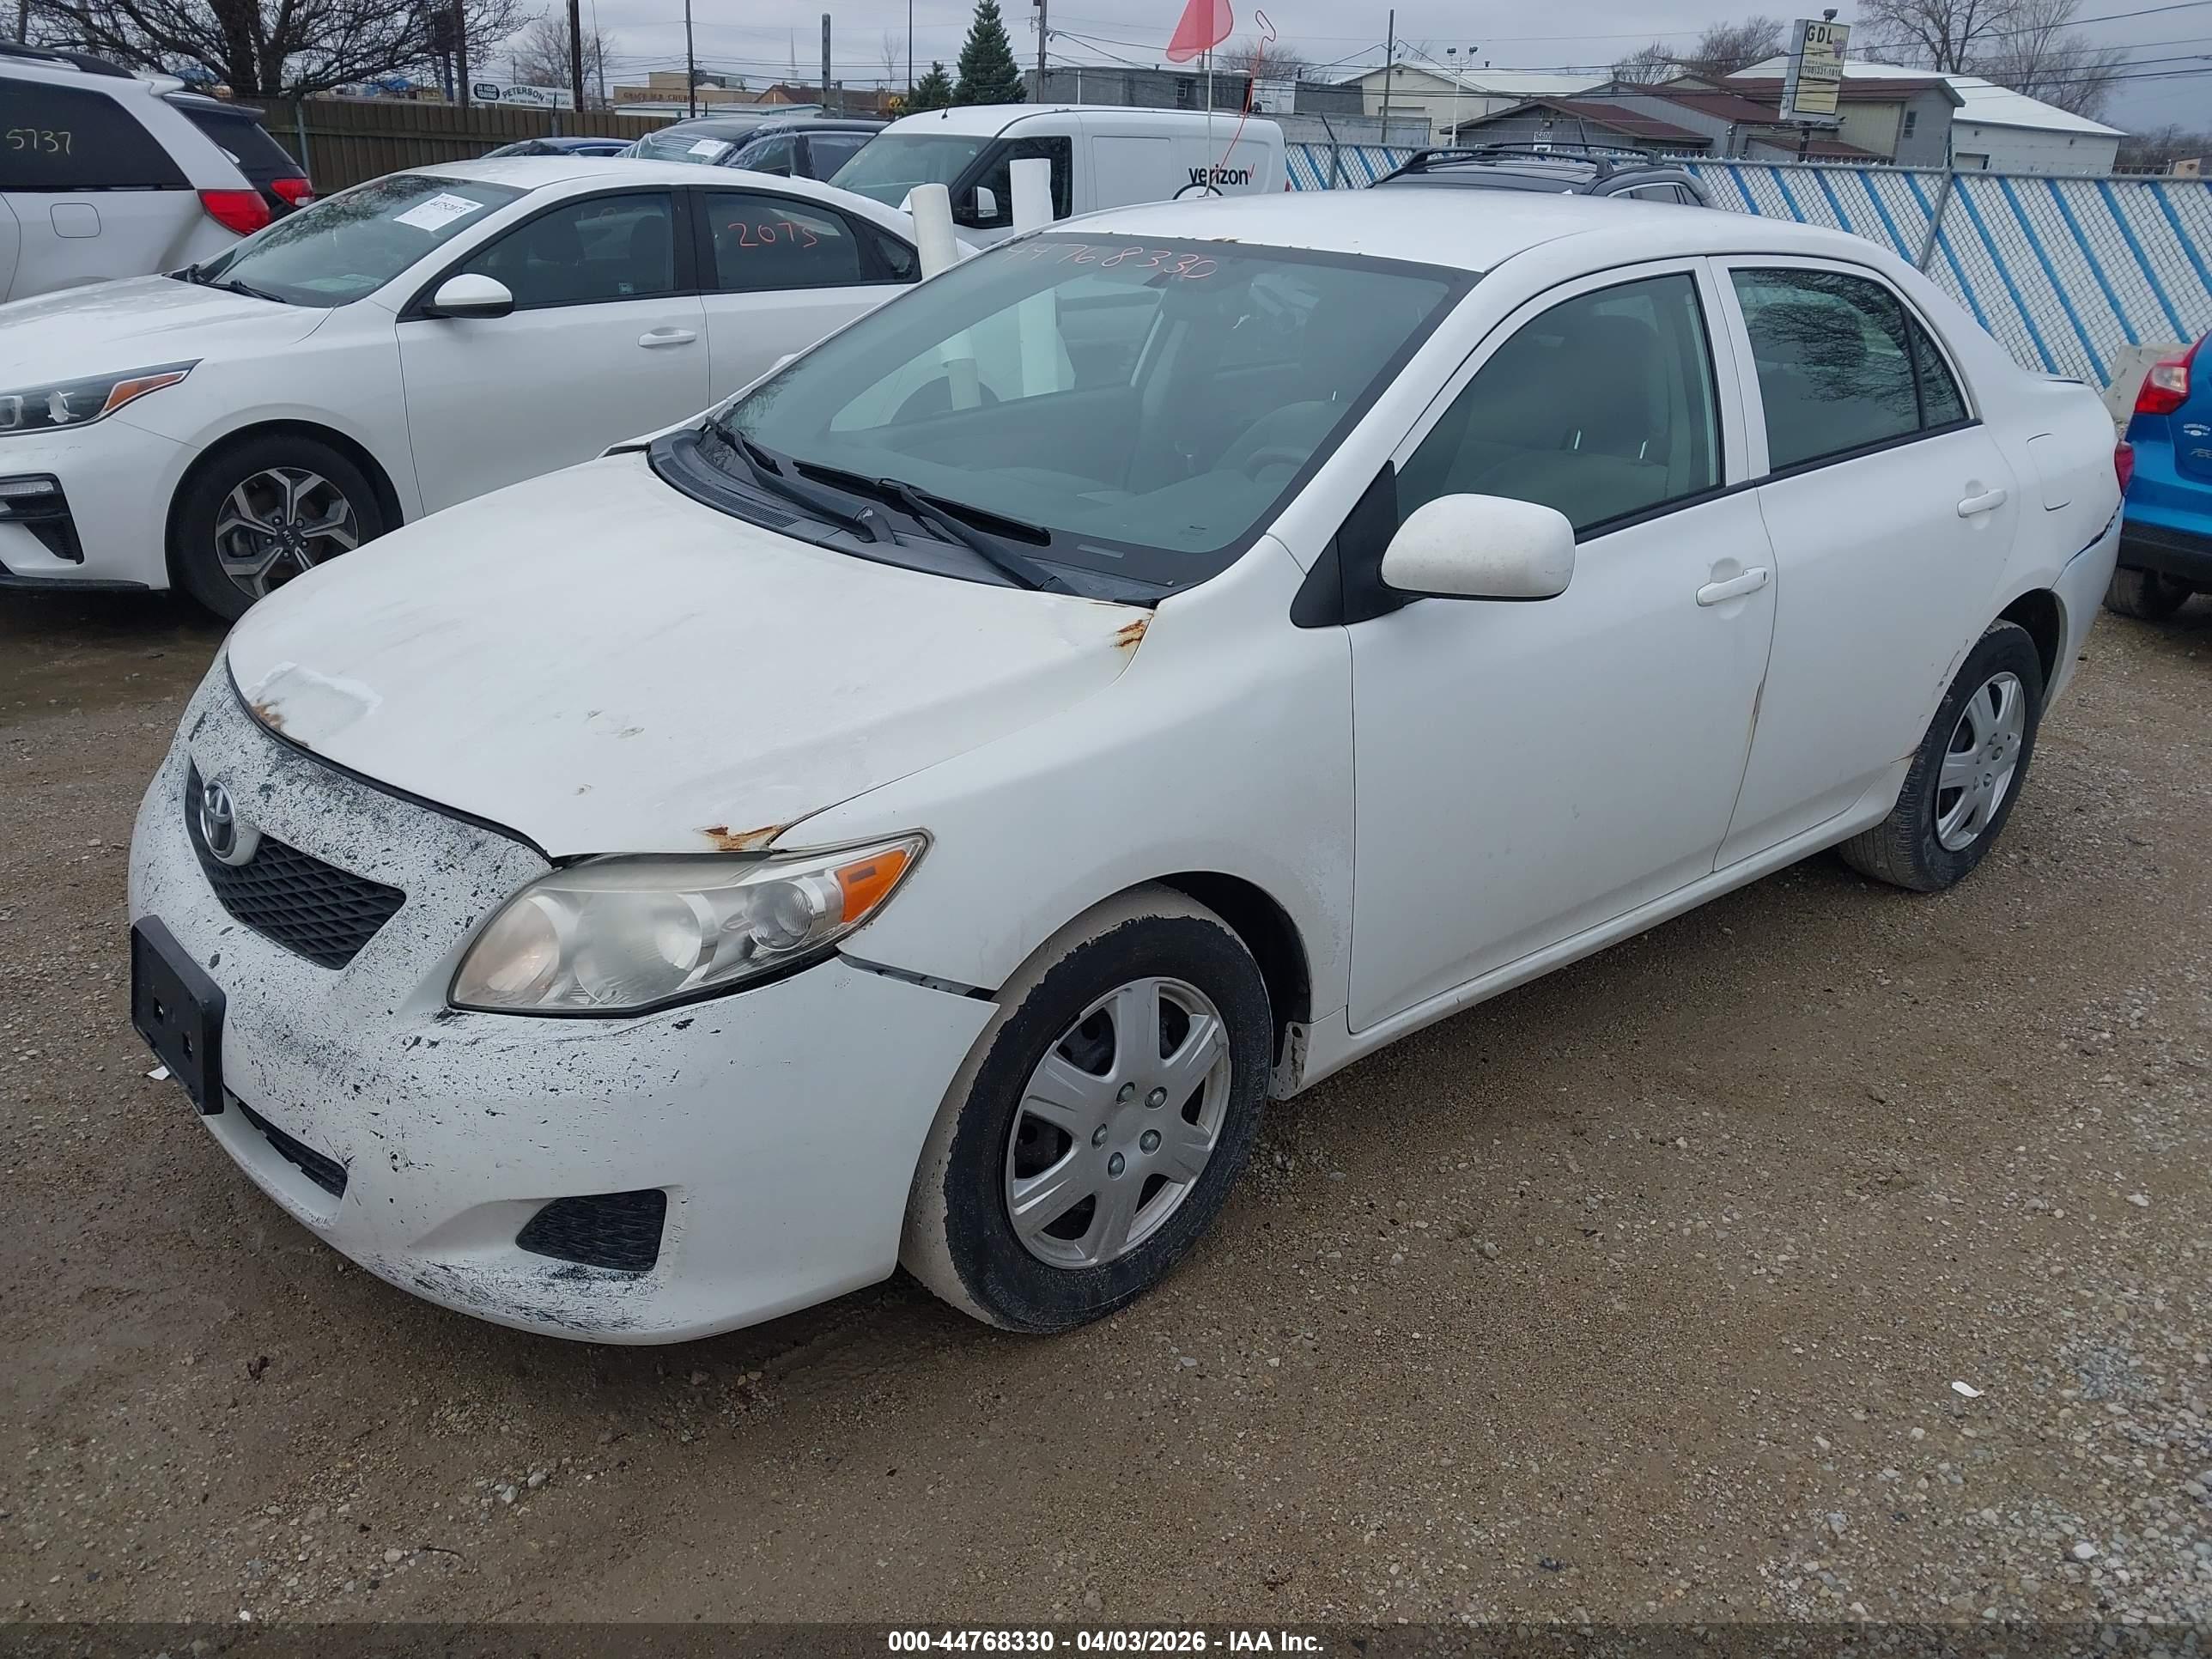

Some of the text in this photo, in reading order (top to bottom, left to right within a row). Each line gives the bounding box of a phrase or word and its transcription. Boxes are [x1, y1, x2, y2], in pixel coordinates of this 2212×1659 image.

[1807, 25, 1833, 45] GDL
[502, 86, 545, 101] PETERSON
[6, 128, 71, 155] 5737
[1188, 163, 1249, 185] verizon
